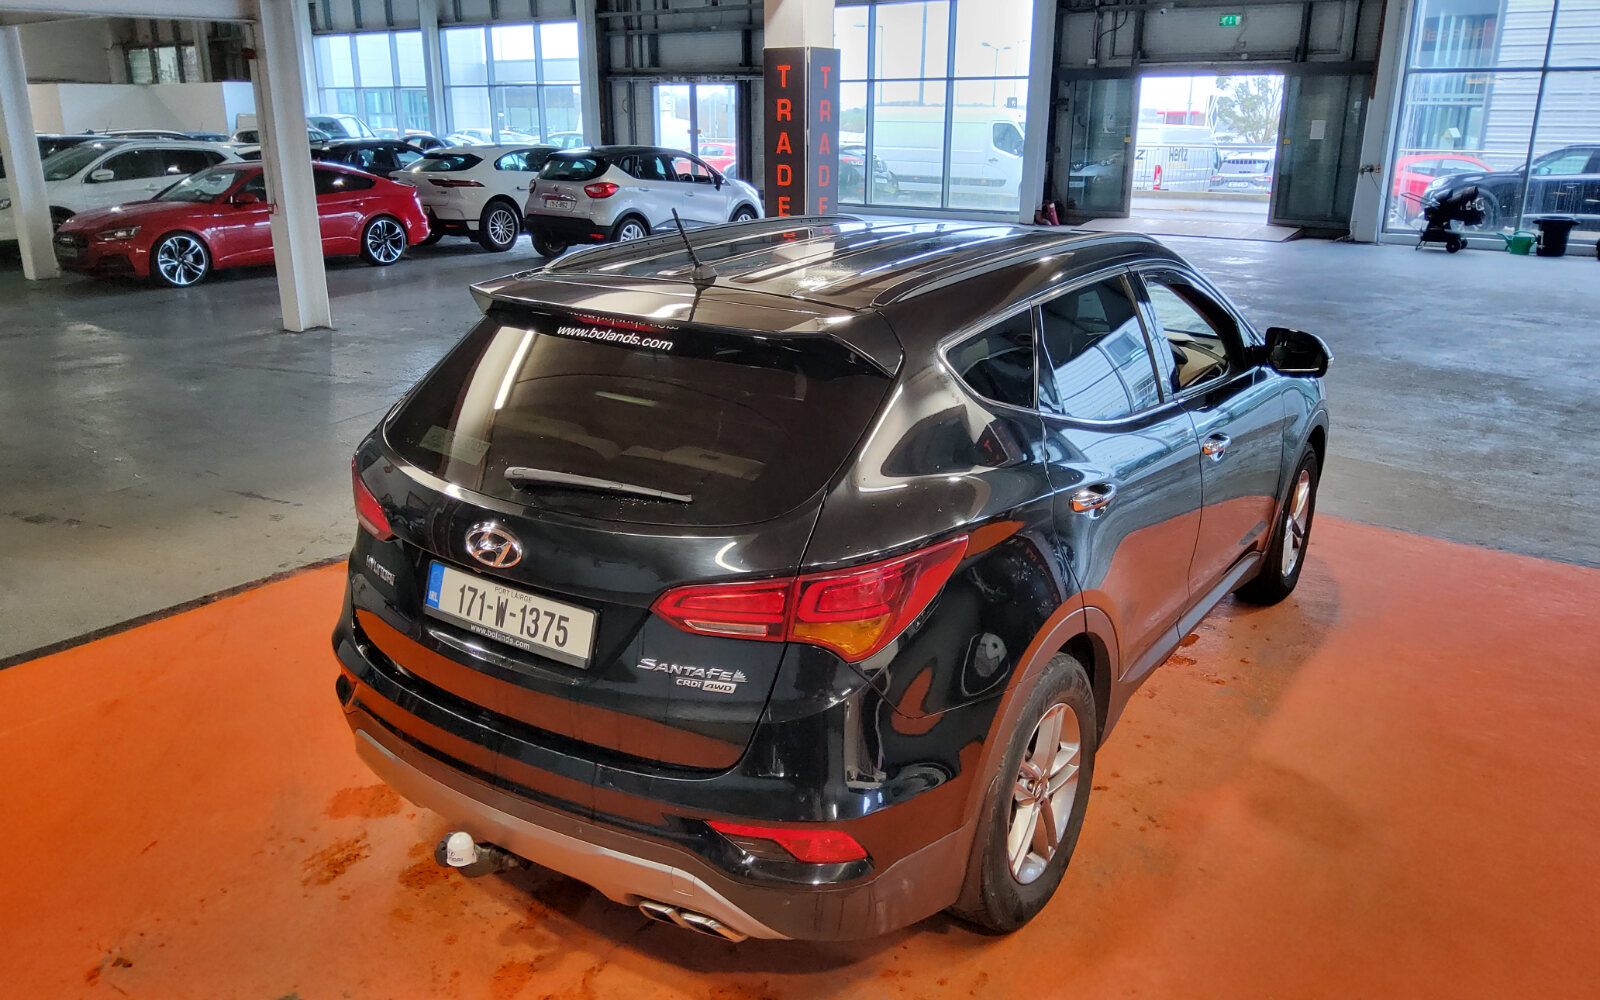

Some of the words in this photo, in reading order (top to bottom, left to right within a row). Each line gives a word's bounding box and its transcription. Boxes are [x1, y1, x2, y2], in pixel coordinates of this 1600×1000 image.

[776, 65, 792, 217] TRADE
[557, 326, 673, 350] www.bolands.com
[458, 584, 570, 647] 171-W-1375
[470, 624, 530, 650] www.bolands.com
